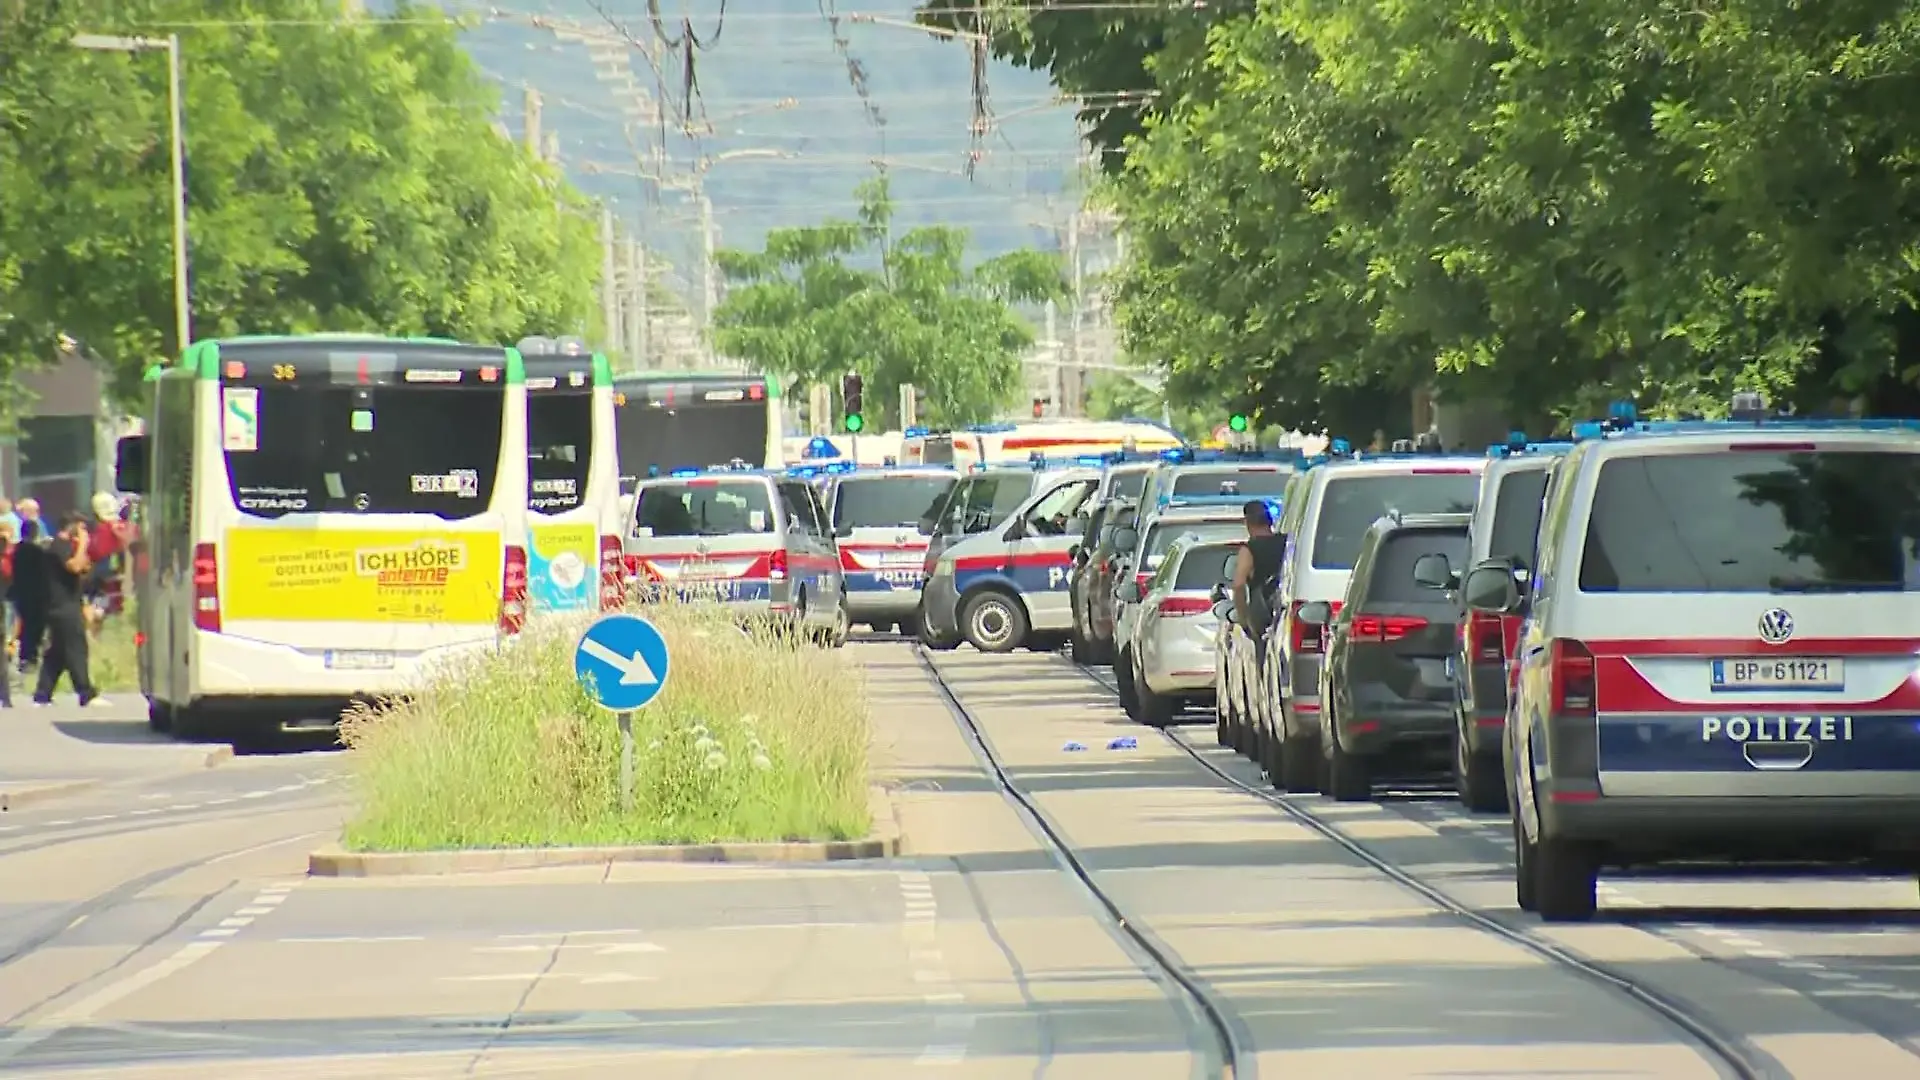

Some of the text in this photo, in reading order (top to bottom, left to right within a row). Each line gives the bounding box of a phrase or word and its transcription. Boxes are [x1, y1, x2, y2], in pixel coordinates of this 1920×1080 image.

[240, 499, 307, 508] CITARO
[359, 544, 460, 570] ICH HÖRE
[378, 564, 448, 582] antenne
[873, 570, 925, 582] POLIZE
[1735, 662, 1828, 680] BP 61121
[1702, 716, 1852, 741] POLIZEI
